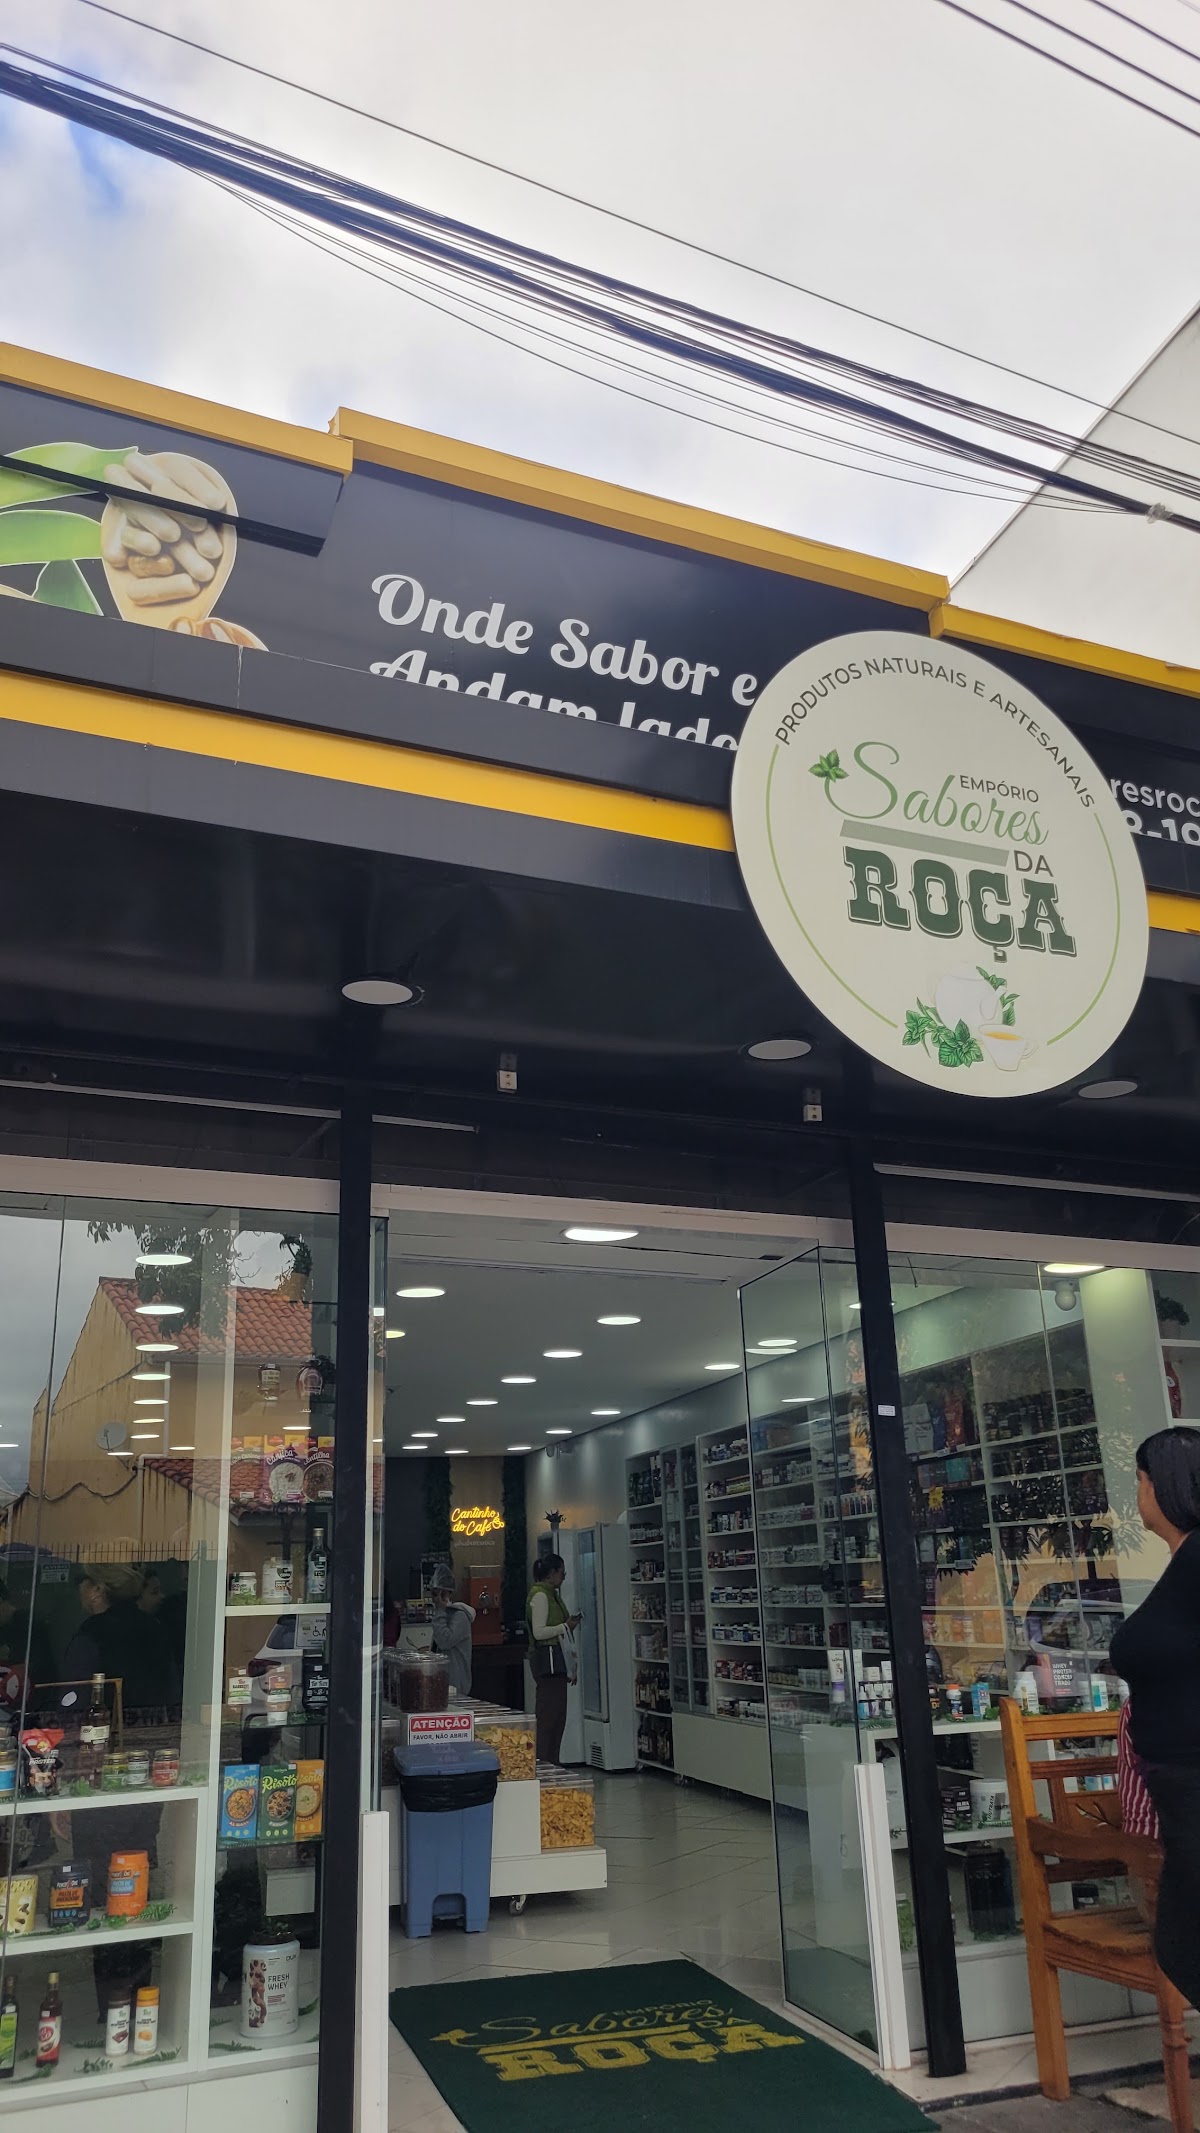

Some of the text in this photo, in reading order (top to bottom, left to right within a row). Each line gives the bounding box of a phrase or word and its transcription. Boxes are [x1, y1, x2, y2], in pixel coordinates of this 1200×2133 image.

[371, 573, 758, 707] Onde Sabor e
[774, 657, 1095, 808] PRODUTOS NATURAIS E ARTESANAIS
[824, 740, 1049, 848] Sabores
[959, 774, 1039, 803] EMPÓRIO
[1014, 849, 1054, 878] DA
[843, 845, 1078, 963] ROÇA
[451, 1506, 497, 1523] Cantinho
[452, 1519, 466, 1532] do
[412, 1717, 470, 1730] ATENÇÃO
[223, 1775, 258, 1794] Risoto
[262, 1773, 298, 1794] Risoto
[267, 1982, 288, 1991] WHEY
[268, 1972, 290, 1983] FRESH
[450, 2006, 733, 2047] Sabores
[695, 2017, 751, 2029] DA
[480, 2023, 805, 2081] ROÇA
